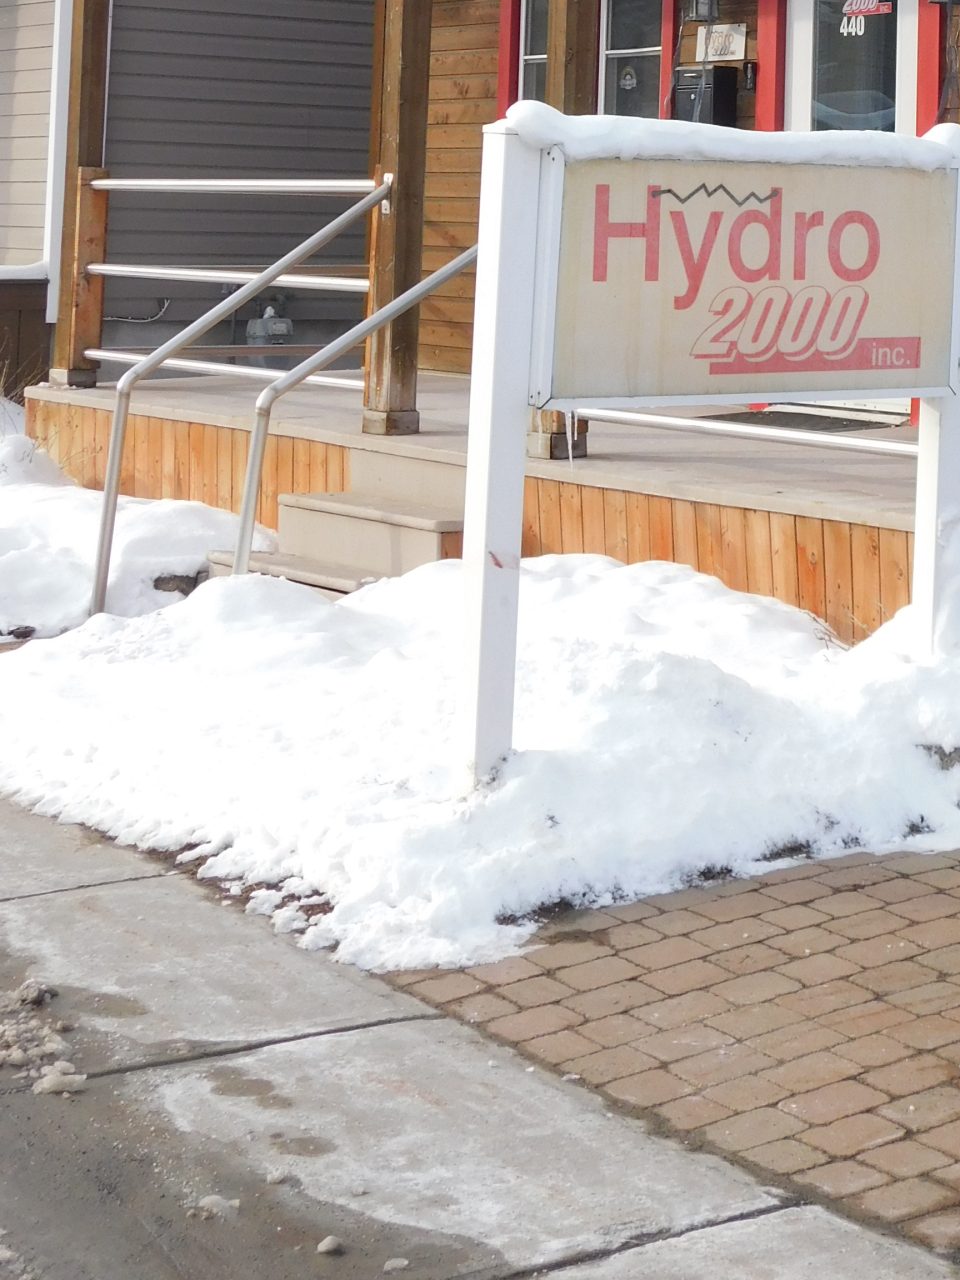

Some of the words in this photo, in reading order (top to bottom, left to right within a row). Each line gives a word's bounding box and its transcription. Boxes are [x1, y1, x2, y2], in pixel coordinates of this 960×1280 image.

[840, 15, 865, 36] 440
[592, 184, 881, 310] Hydro
[689, 285, 869, 362] 2000
[871, 342, 911, 367] inc.
